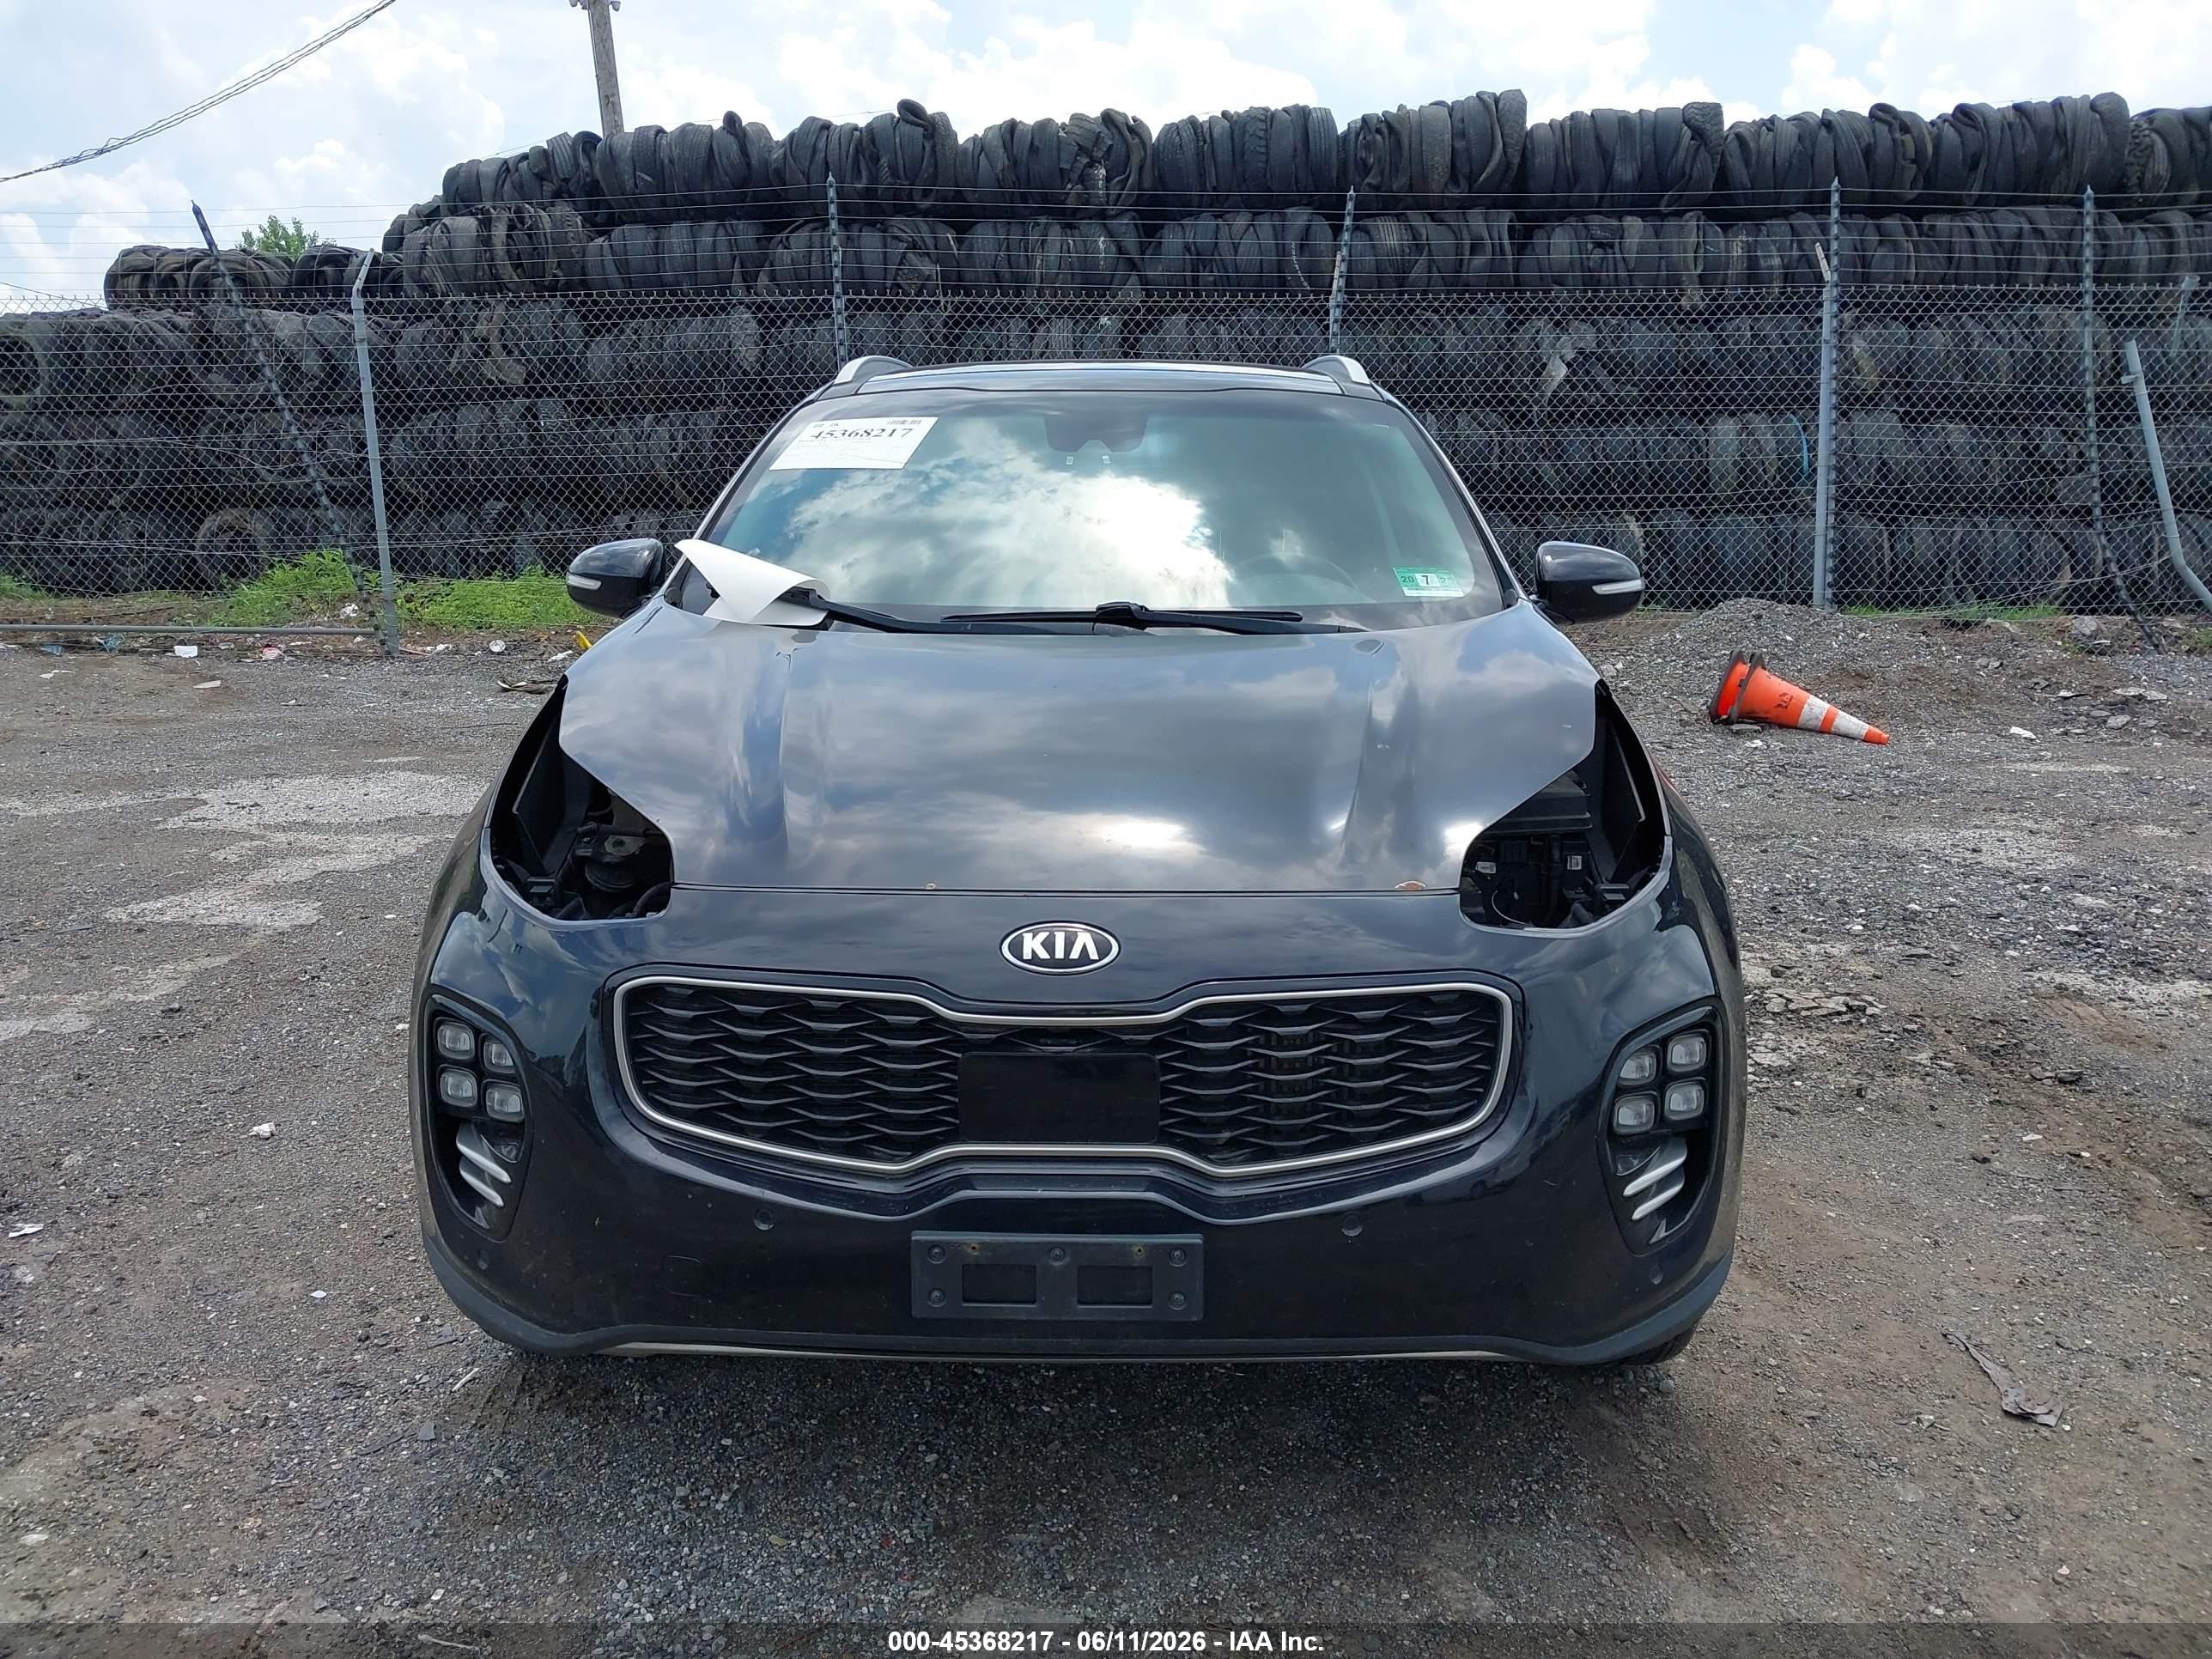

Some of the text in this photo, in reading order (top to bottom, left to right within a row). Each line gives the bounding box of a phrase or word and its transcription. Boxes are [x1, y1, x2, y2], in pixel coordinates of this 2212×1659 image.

[810, 428, 914, 440] 45368217
[1401, 575, 1415, 584] 20
[1421, 574, 1430, 586] 7
[1021, 931, 1100, 960] KIA
